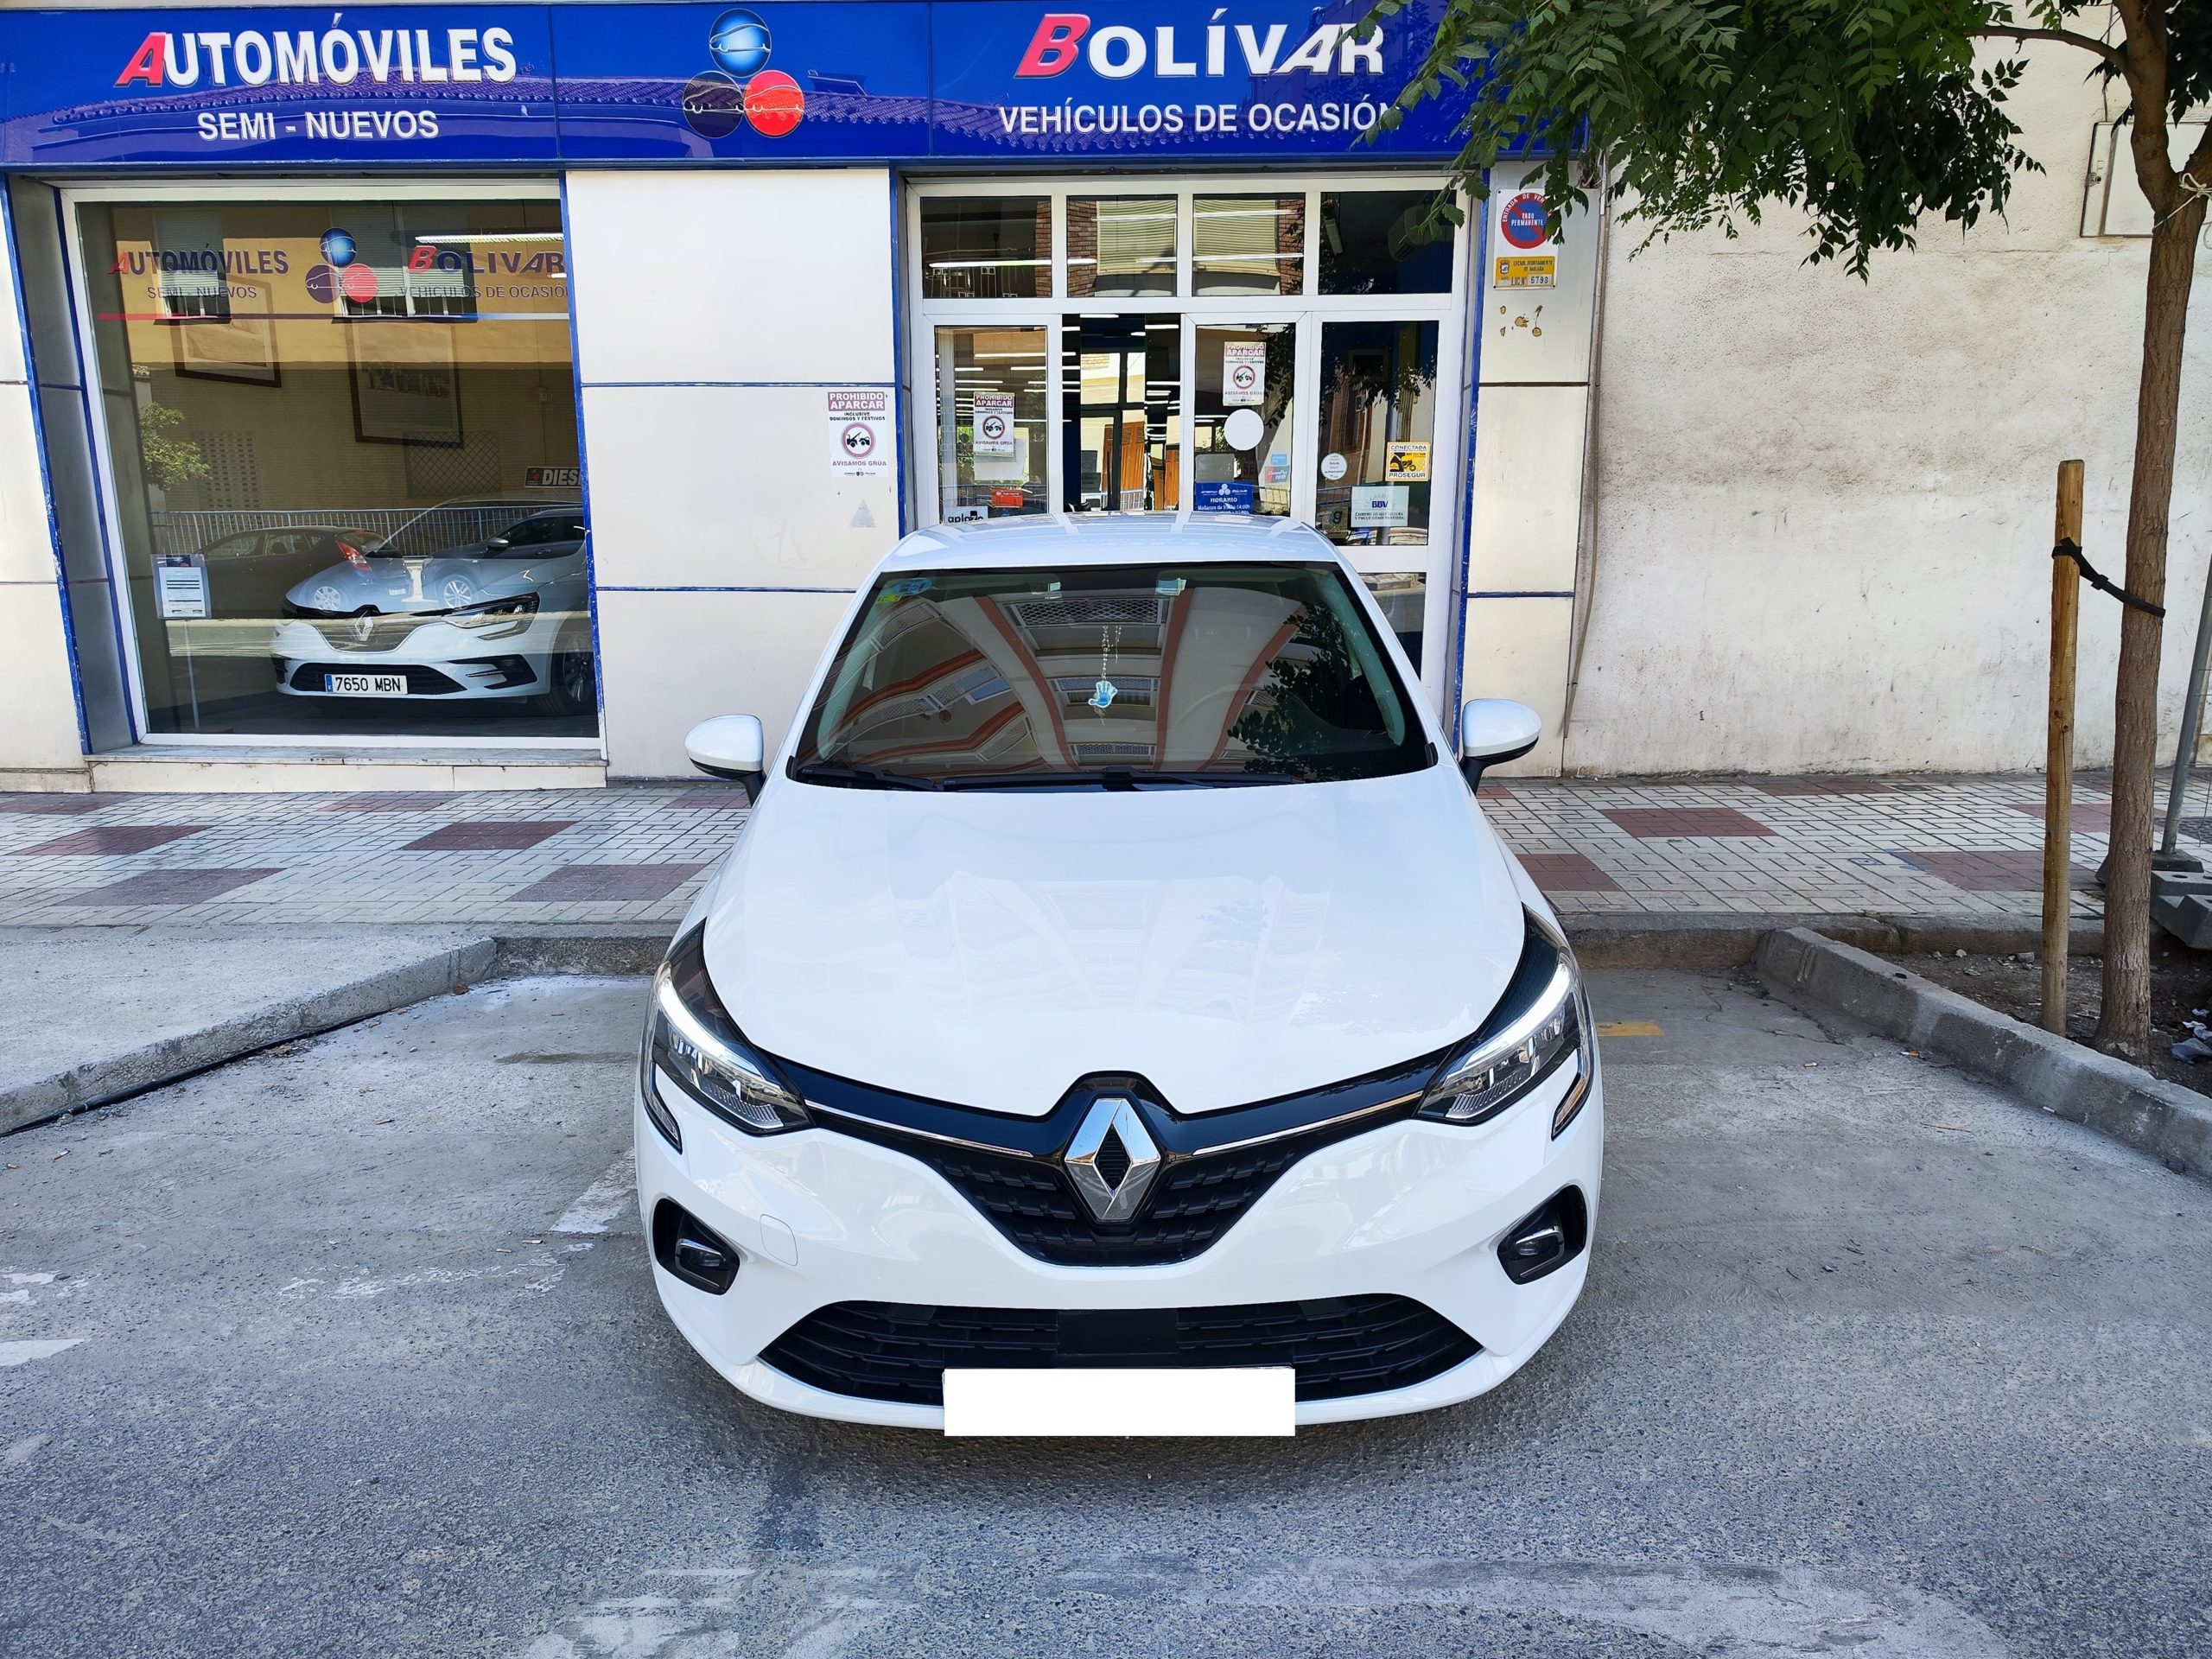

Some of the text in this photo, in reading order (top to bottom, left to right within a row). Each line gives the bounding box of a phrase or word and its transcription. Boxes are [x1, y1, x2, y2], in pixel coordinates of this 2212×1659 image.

[116, 13, 517, 87] AUTOMÓVILES
[1014, 8, 1383, 79] BOLÍVAR
[198, 112, 276, 140] SEMI
[304, 110, 439, 140] NUEVOS
[999, 97, 1185, 135] VEHÍCULOS
[1195, 104, 1237, 133] DE
[1502, 198, 1518, 223] ENTRADA
[108, 243, 289, 276] AUTOMÓVILES
[147, 287, 182, 299] SEMI
[197, 286, 257, 299] NUEVOS
[486, 286, 505, 298] DE
[830, 401, 884, 410] APARCAR
[334, 677, 401, 692] 7650 MBN
